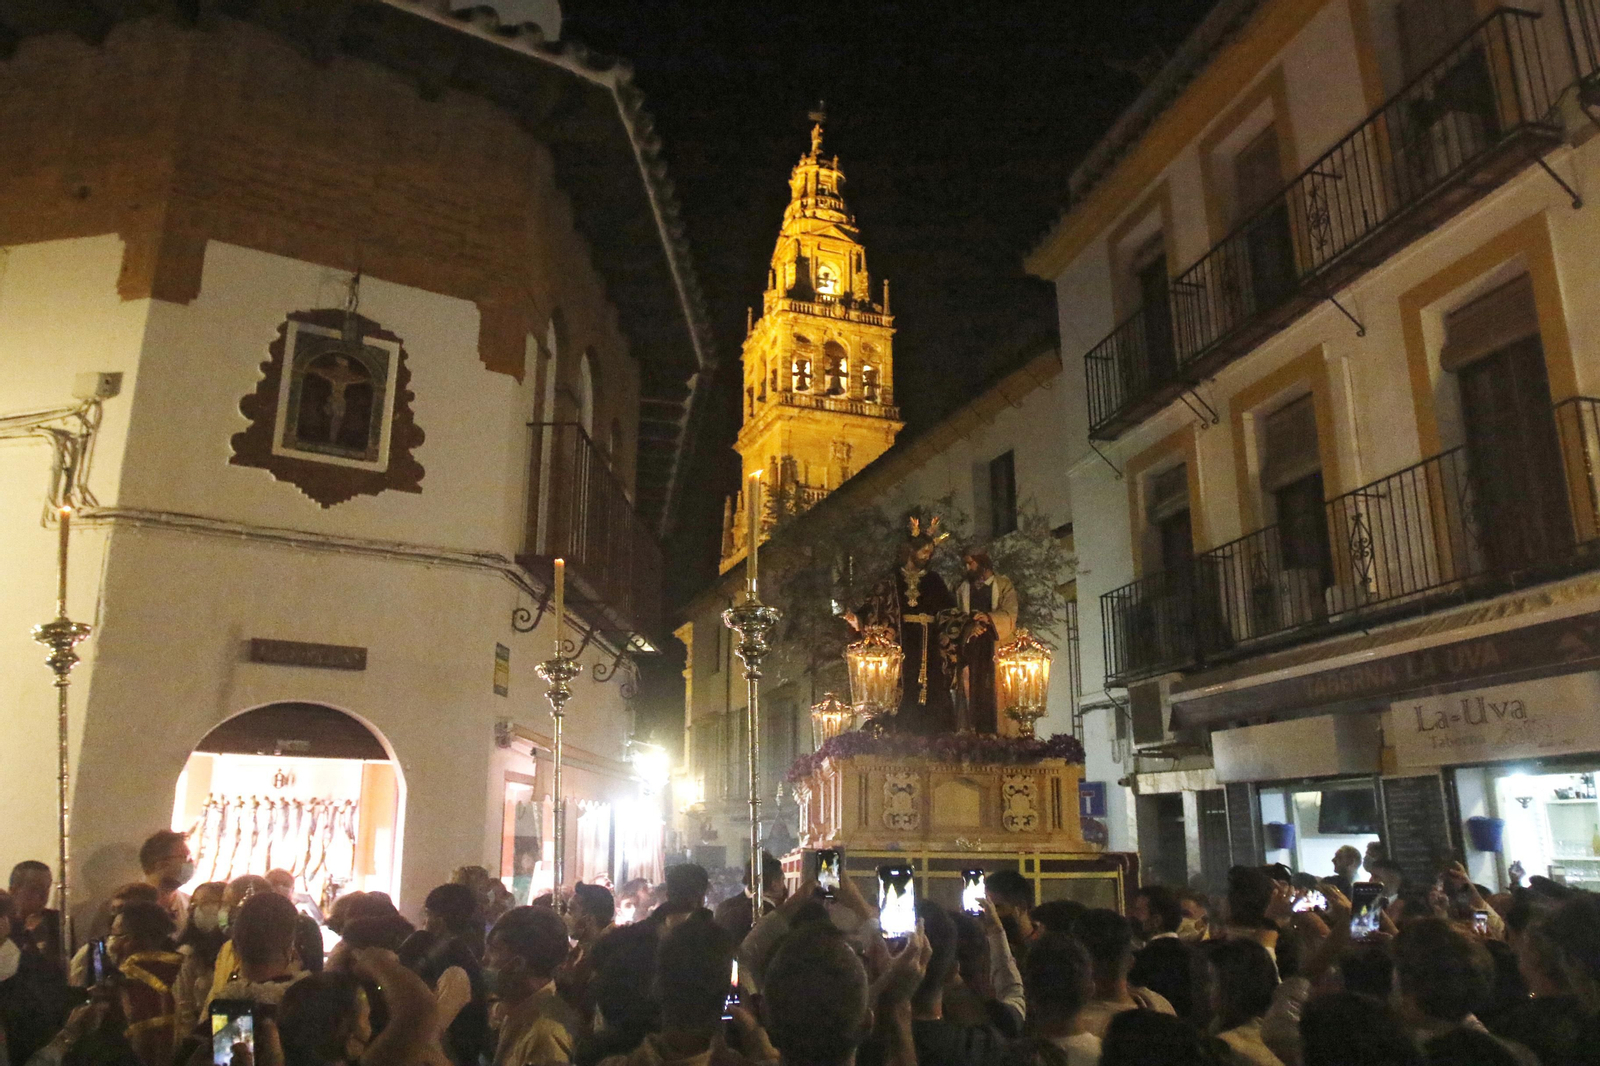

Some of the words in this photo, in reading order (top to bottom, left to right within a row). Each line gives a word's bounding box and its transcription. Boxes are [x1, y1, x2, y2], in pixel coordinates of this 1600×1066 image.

[1304, 664, 1397, 698] TABERNA
[1407, 654, 1438, 681] LA
[1448, 641, 1500, 673] UVA
